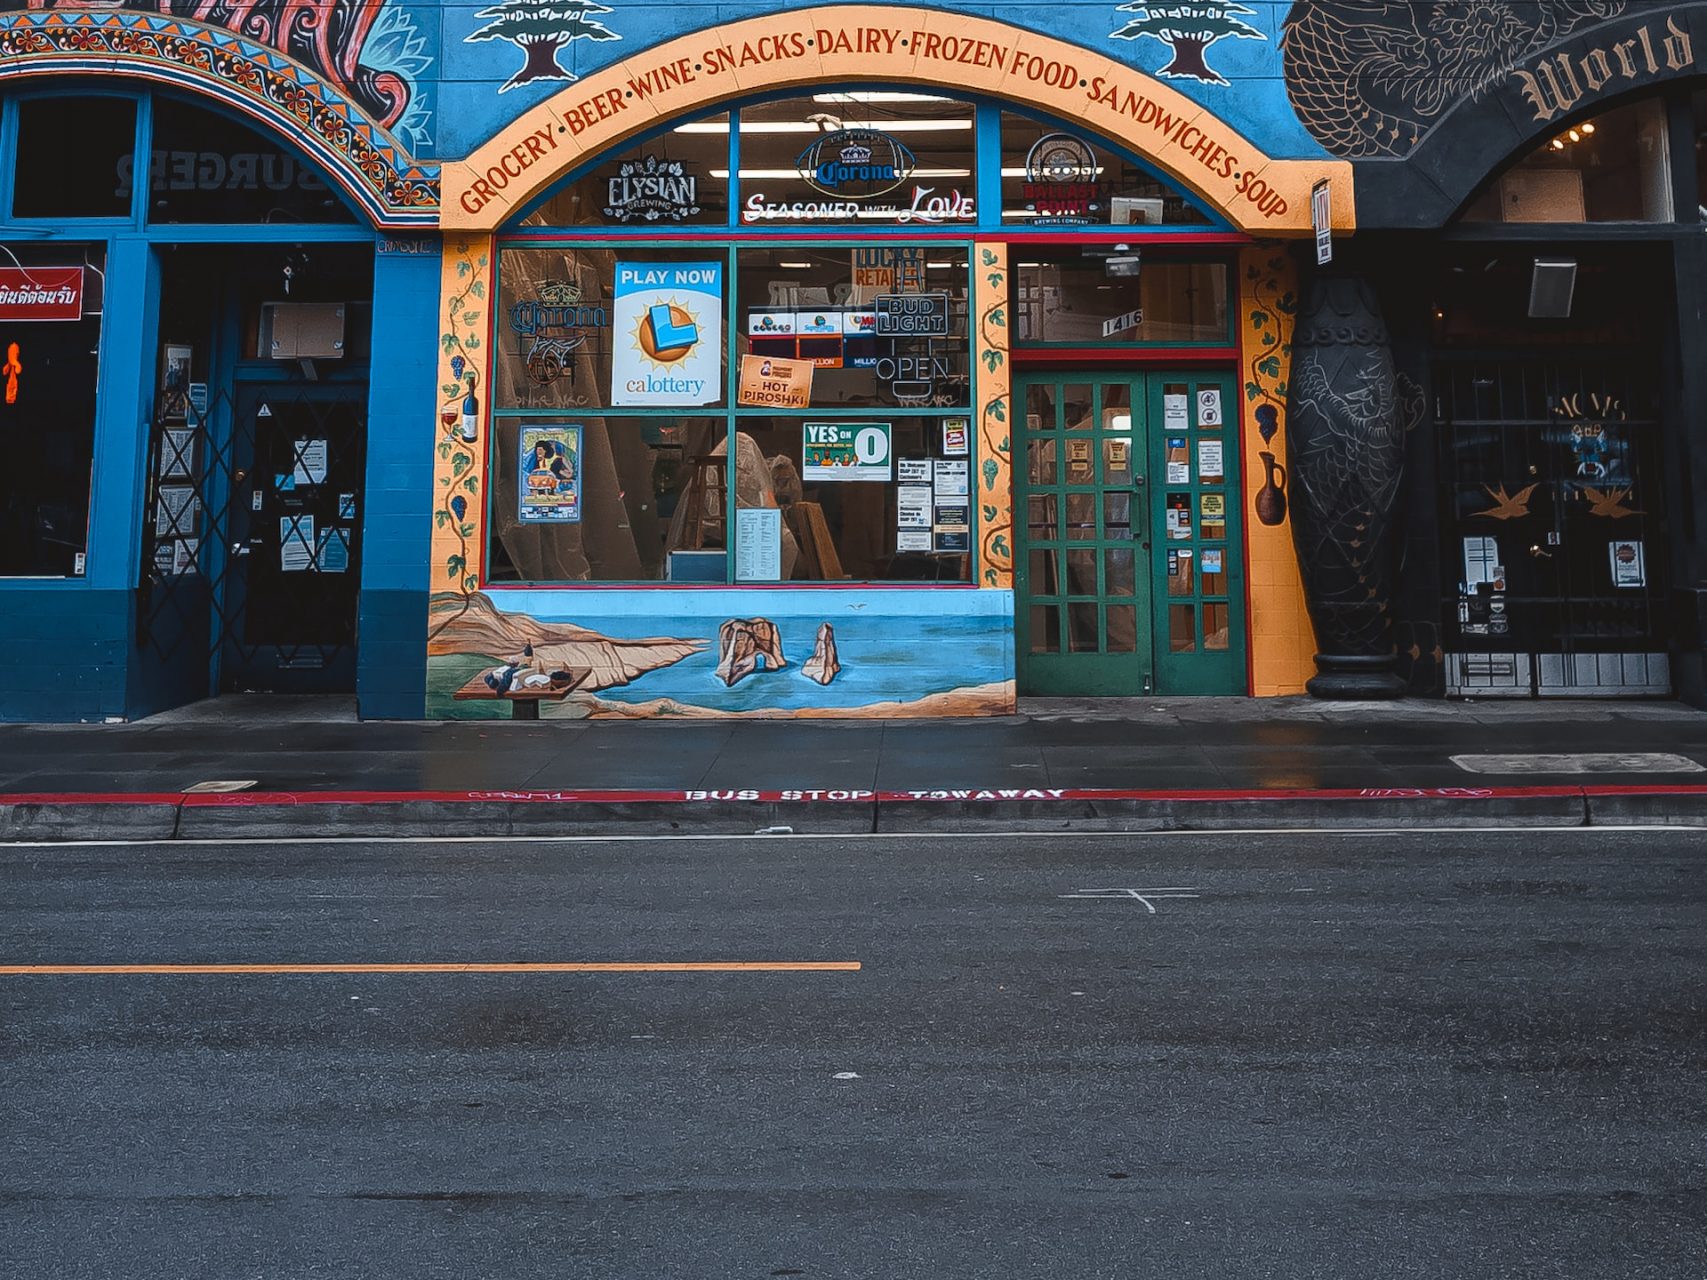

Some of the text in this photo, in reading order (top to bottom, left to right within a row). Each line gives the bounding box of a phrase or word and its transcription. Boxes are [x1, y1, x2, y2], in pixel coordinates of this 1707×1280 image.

[1512, 16, 1694, 121] World
[460, 124, 560, 215] GROCERY
[563, 88, 628, 137] BEER
[628, 58, 697, 101] WINE
[702, 32, 807, 76] SNACKS
[816, 28, 902, 55] DAIRY
[910, 31, 1007, 70] FROZEN
[1010, 51, 1079, 91] FOOD
[1086, 77, 1239, 178] SANDWICHES
[1235, 170, 1289, 220] SOUP
[815, 160, 896, 189] Corona
[608, 176, 696, 206] ELYSIAN
[1023, 184, 1100, 199] BALLAST
[627, 199, 673, 210] BREWING
[1035, 200, 1089, 216] POINT
[621, 269, 716, 285] PLAY NOW
[888, 298, 935, 315] BUD
[509, 300, 607, 335] Corona
[878, 315, 944, 332] LIGHT
[1106, 311, 1142, 334] 1416
[875, 357, 949, 381] OPEN
[626, 374, 705, 397] calottery
[762, 381, 789, 393] HOT
[744, 390, 804, 405] PIROSHKI
[807, 425, 839, 443] YES
[839, 430, 852, 439] ON
[684, 789, 760, 801] BUS
[780, 789, 874, 801] STOP
